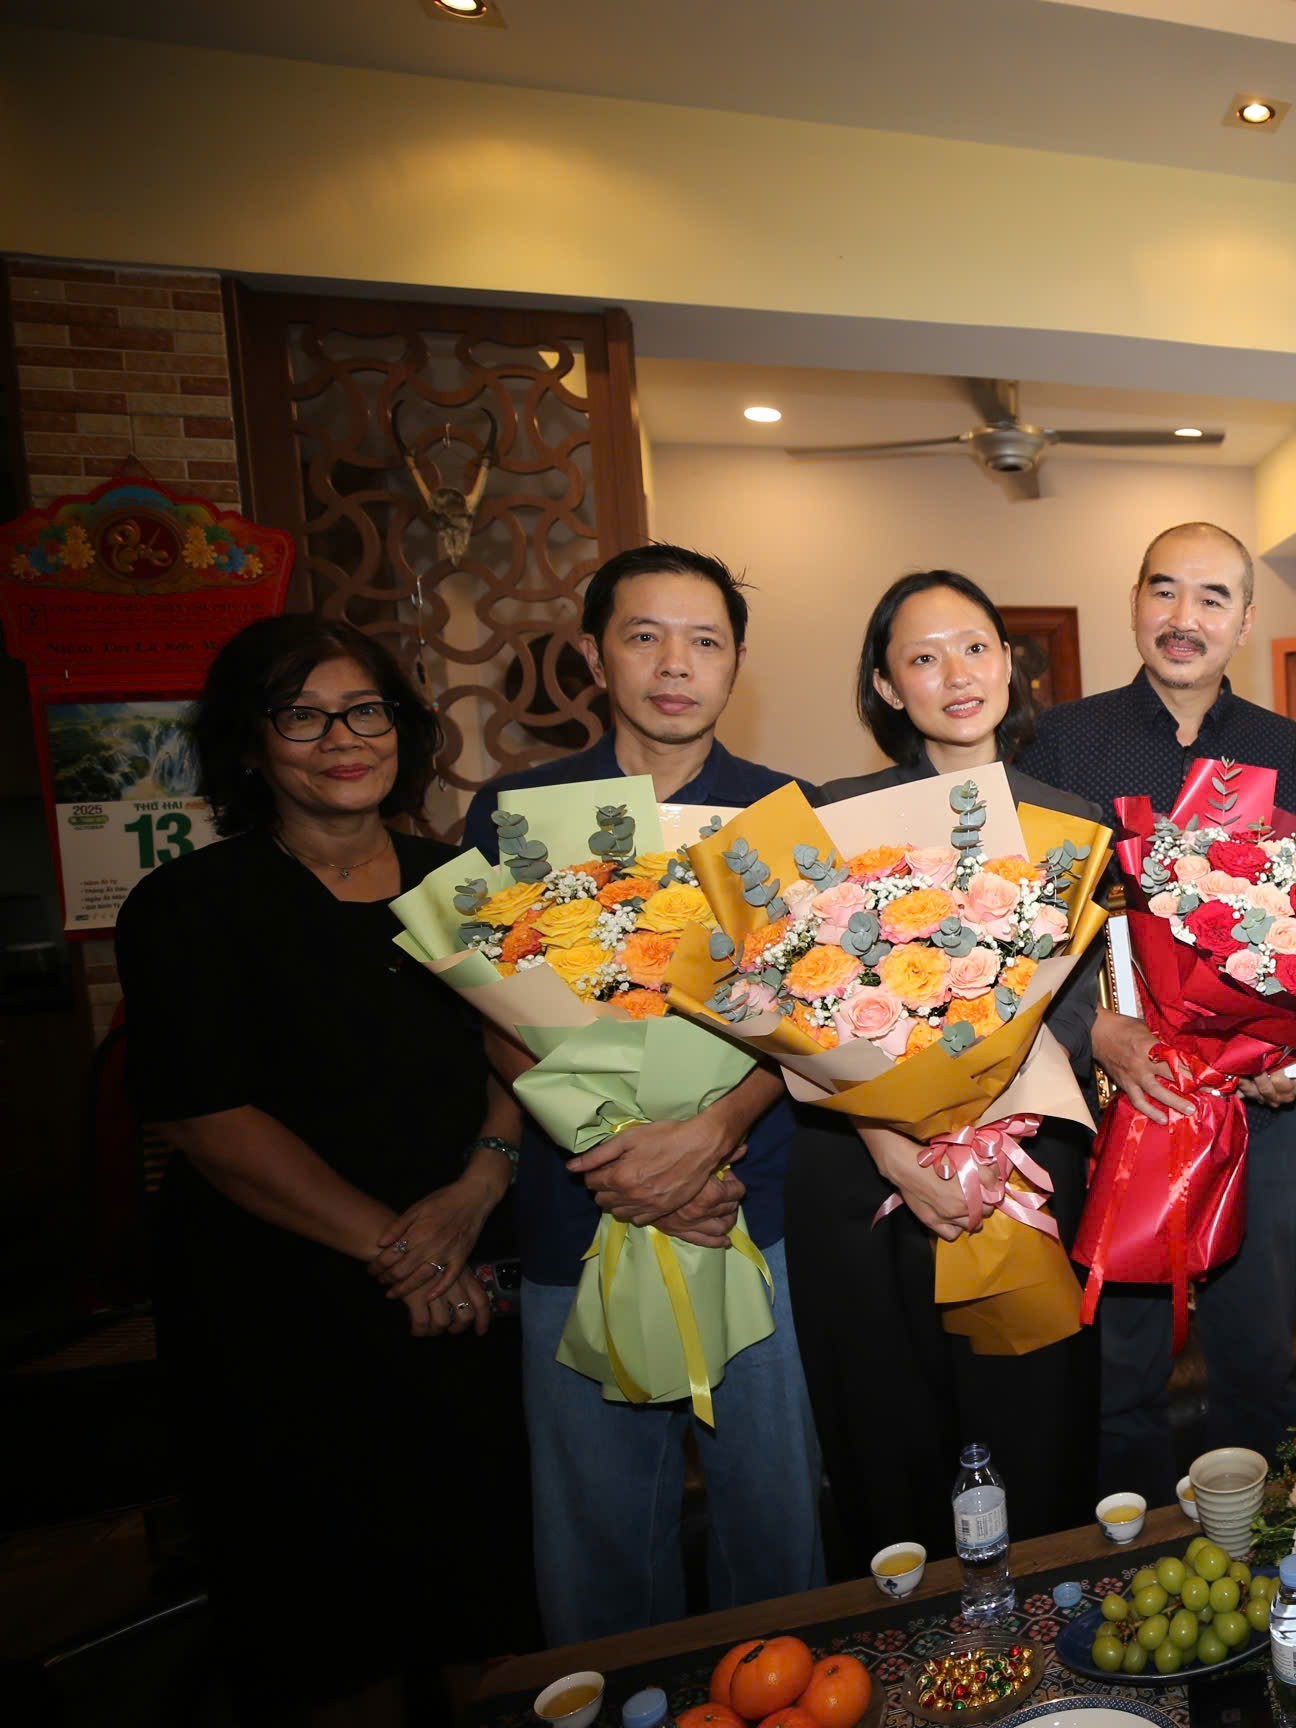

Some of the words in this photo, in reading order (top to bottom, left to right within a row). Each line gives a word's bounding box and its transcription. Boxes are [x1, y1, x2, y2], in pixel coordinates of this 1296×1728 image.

[72, 804, 103, 816] 2025
[133, 801, 160, 812] THỨ
[162, 801, 183, 811] HAI
[124, 812, 195, 869] 13
